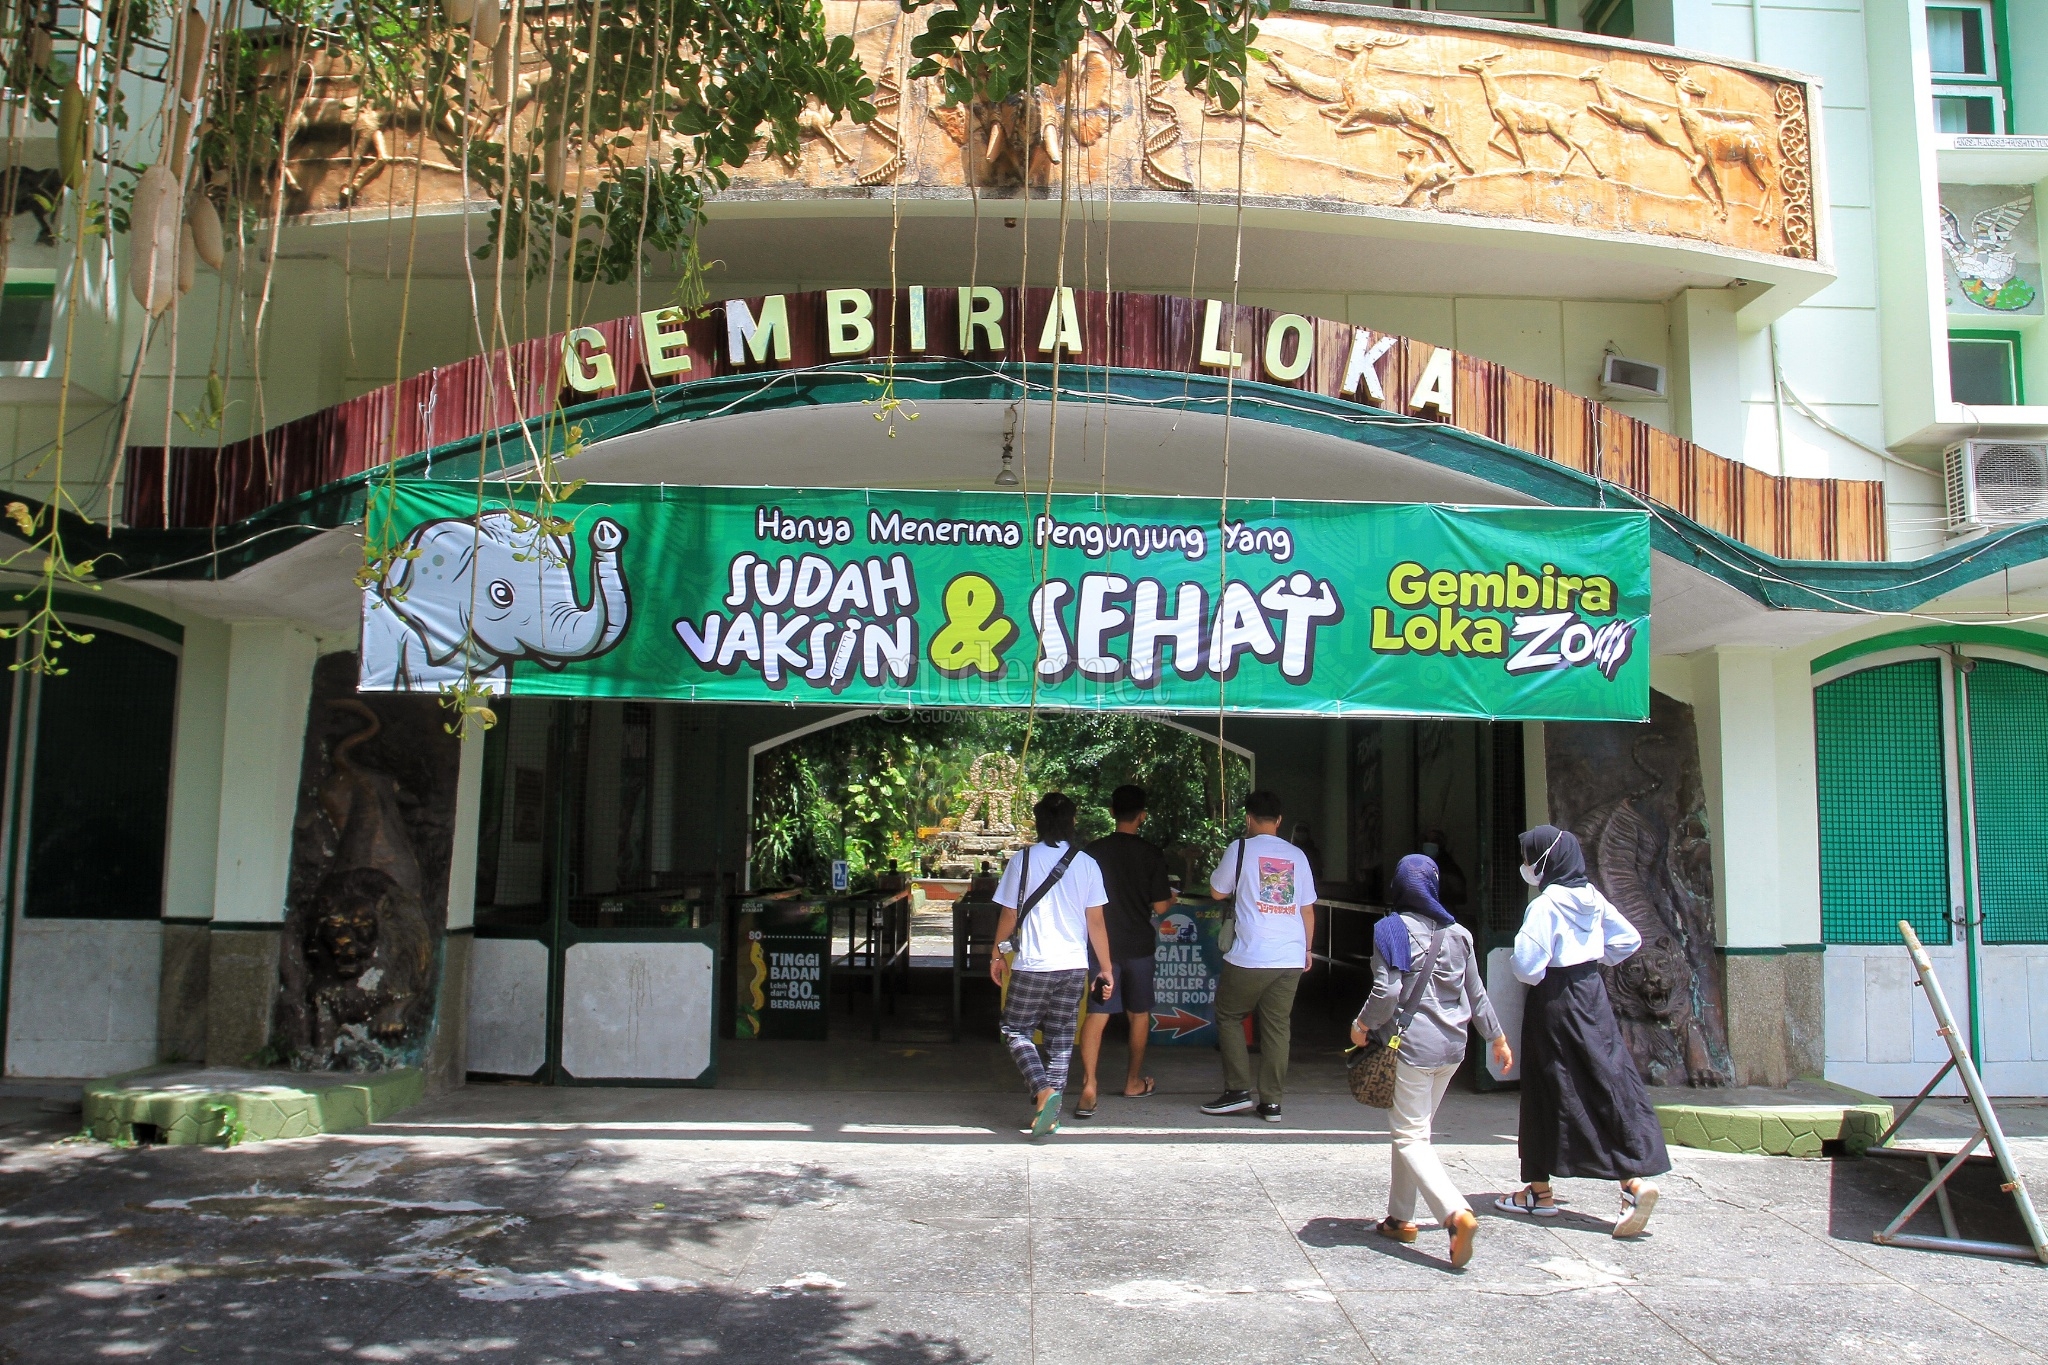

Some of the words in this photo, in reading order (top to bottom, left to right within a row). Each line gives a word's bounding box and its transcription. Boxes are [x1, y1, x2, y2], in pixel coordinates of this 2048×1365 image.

[561, 285, 1084, 395] GEMBIRA
[1200, 299, 1453, 417] LOKA
[758, 508, 851, 545] Hanya
[870, 512, 1020, 546] Menerima
[1037, 516, 1204, 558] Pengunjung
[1220, 521, 1291, 560] Yang
[726, 554, 912, 617] SUDAH
[1388, 562, 1612, 612] Gembira
[930, 575, 1012, 673] &
[1031, 573, 1338, 680] SEHAT
[1371, 607, 1503, 654] Loka
[748, 930, 763, 940] 80
[769, 952, 820, 967] TINGGI
[1154, 945, 1202, 962] GATE
[770, 967, 820, 981] BADAN
[788, 981, 813, 999] 80
[1153, 977, 1203, 990] ROLLER
[1208, 978, 1217, 990] &
[770, 1000, 821, 1010] BERBAYAR
[1181, 991, 1216, 1004] RODA
